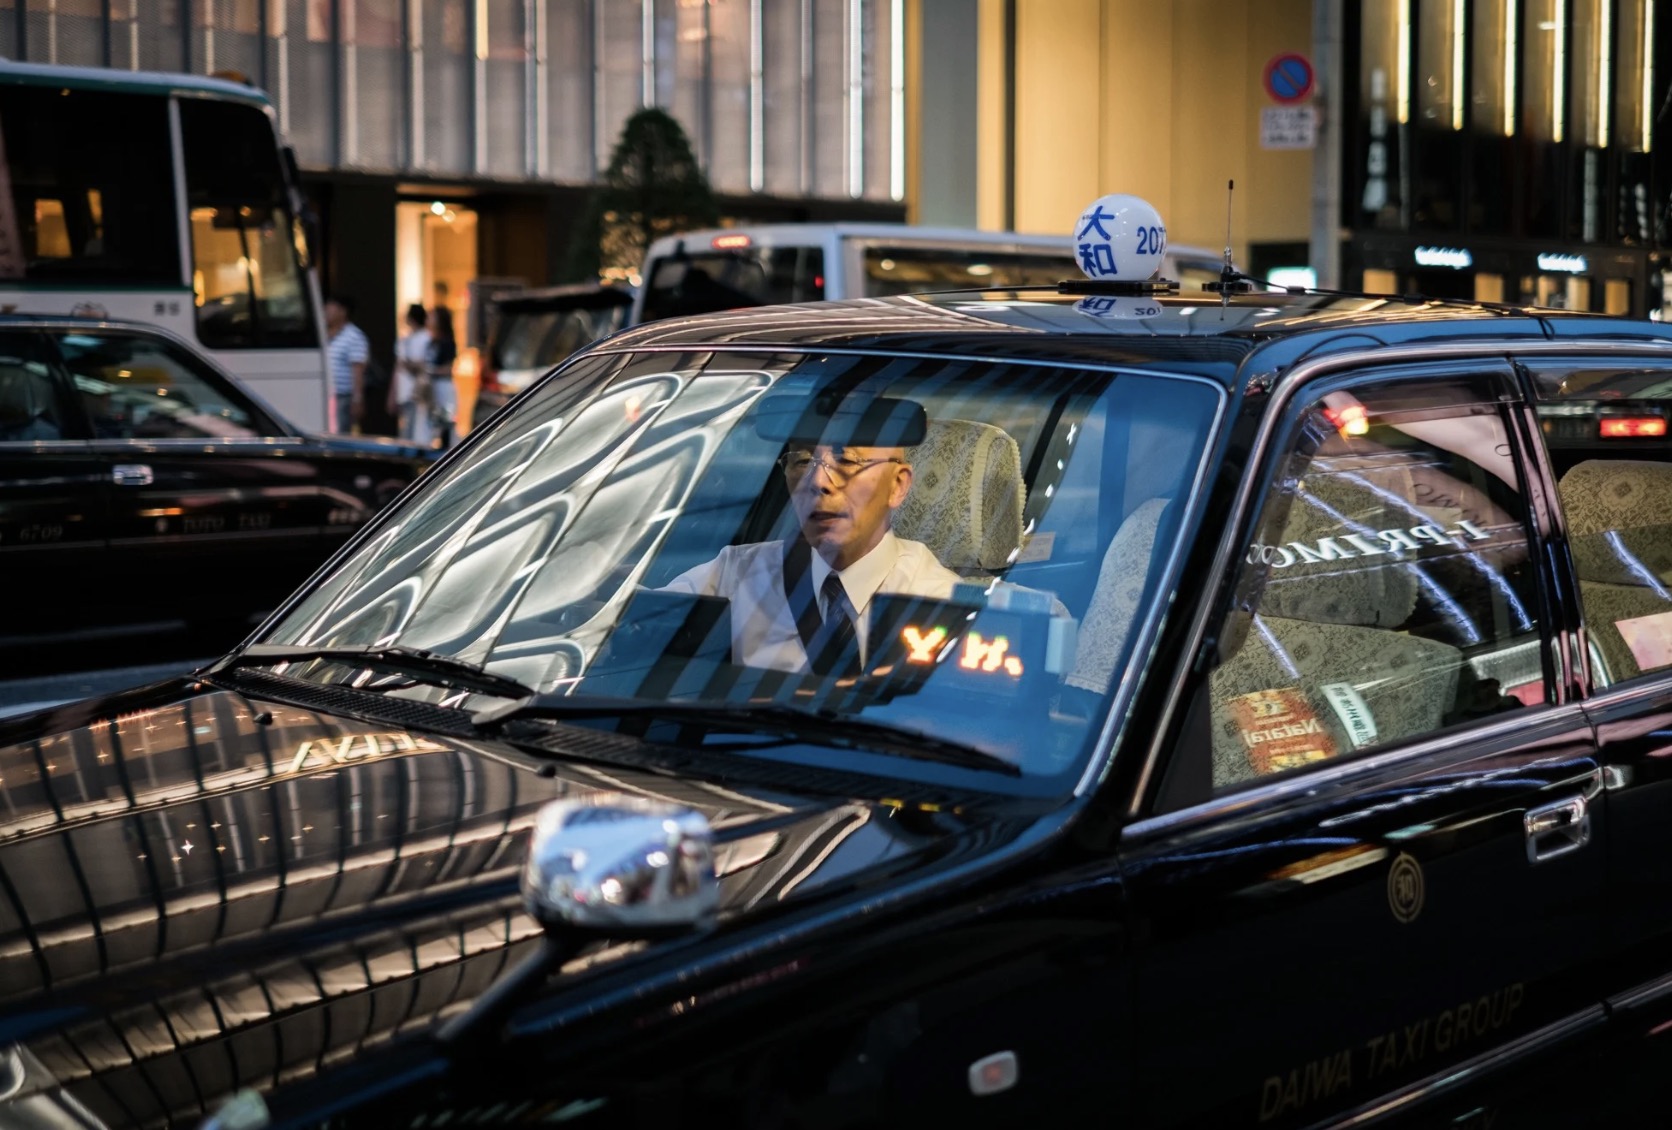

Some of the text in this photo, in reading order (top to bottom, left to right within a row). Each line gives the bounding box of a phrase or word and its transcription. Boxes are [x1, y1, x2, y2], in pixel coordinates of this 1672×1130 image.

[1077, 205, 1117, 277] 大和
[1258, 981, 1525, 1123] DAIWA TAXI GROUP
